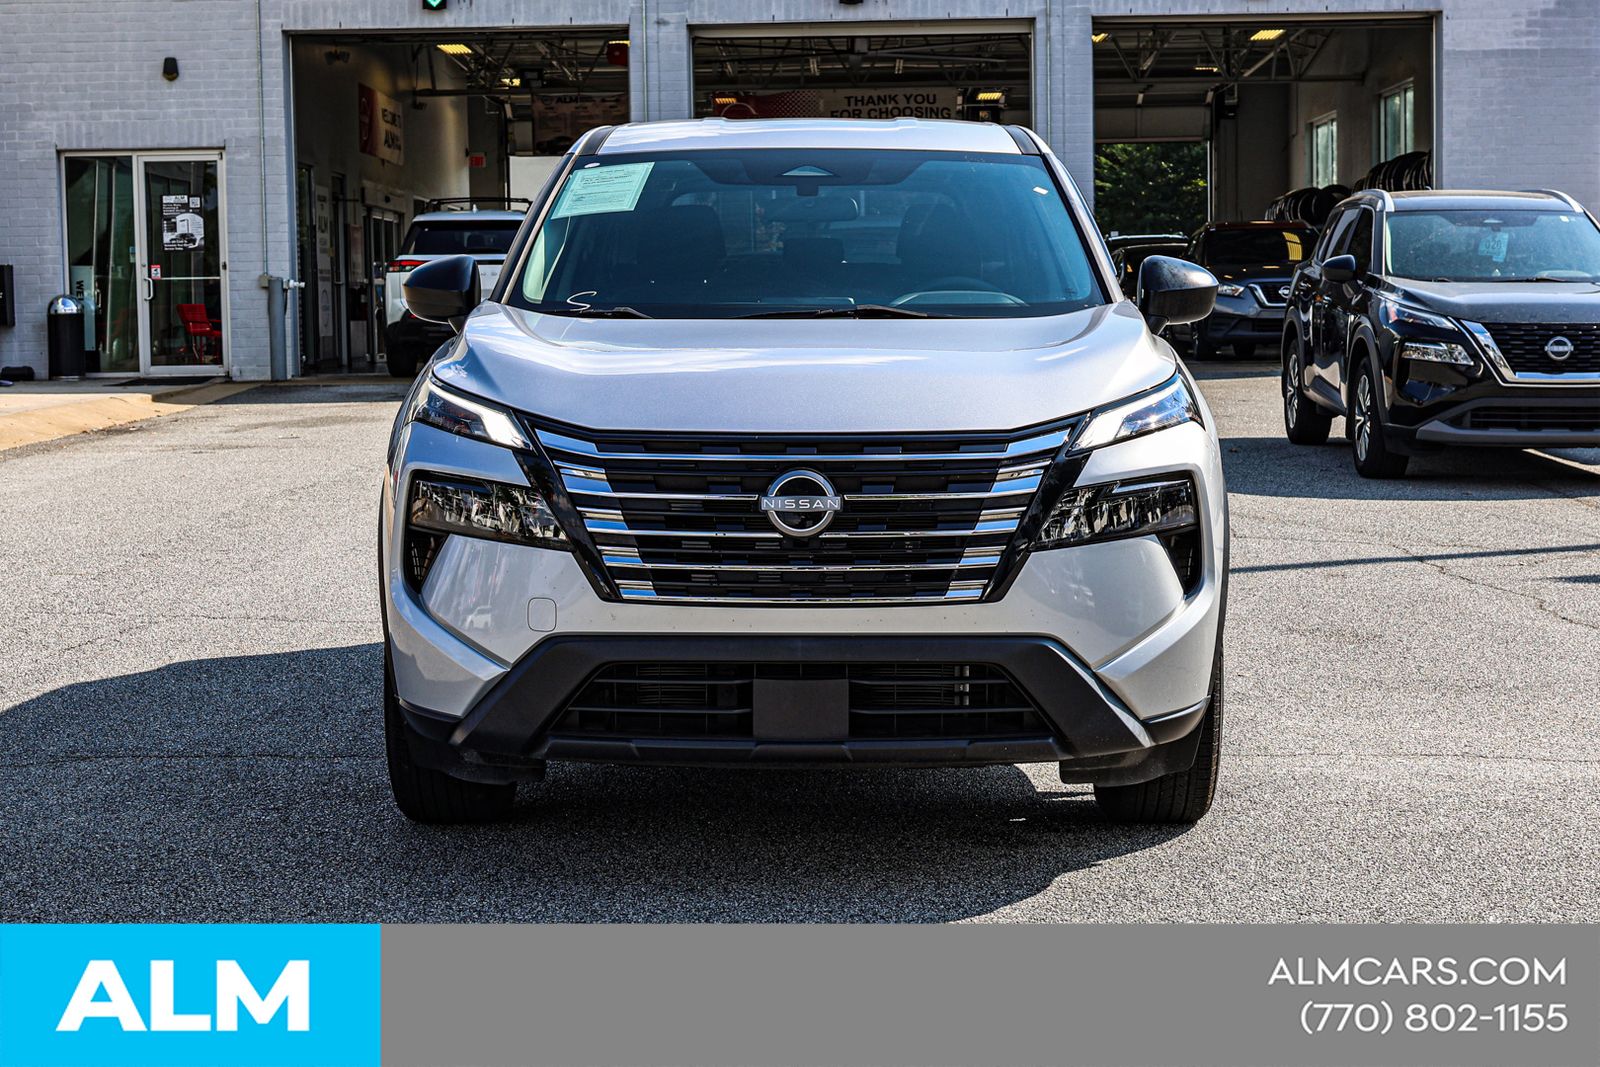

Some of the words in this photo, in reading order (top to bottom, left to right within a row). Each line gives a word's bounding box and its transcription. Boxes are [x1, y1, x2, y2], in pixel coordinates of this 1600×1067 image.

[844, 95, 898, 107] THANK
[903, 93, 937, 105] YOU
[830, 109, 862, 119] FOR
[867, 107, 950, 119] CHOOSING
[763, 499, 839, 509] NISSAN
